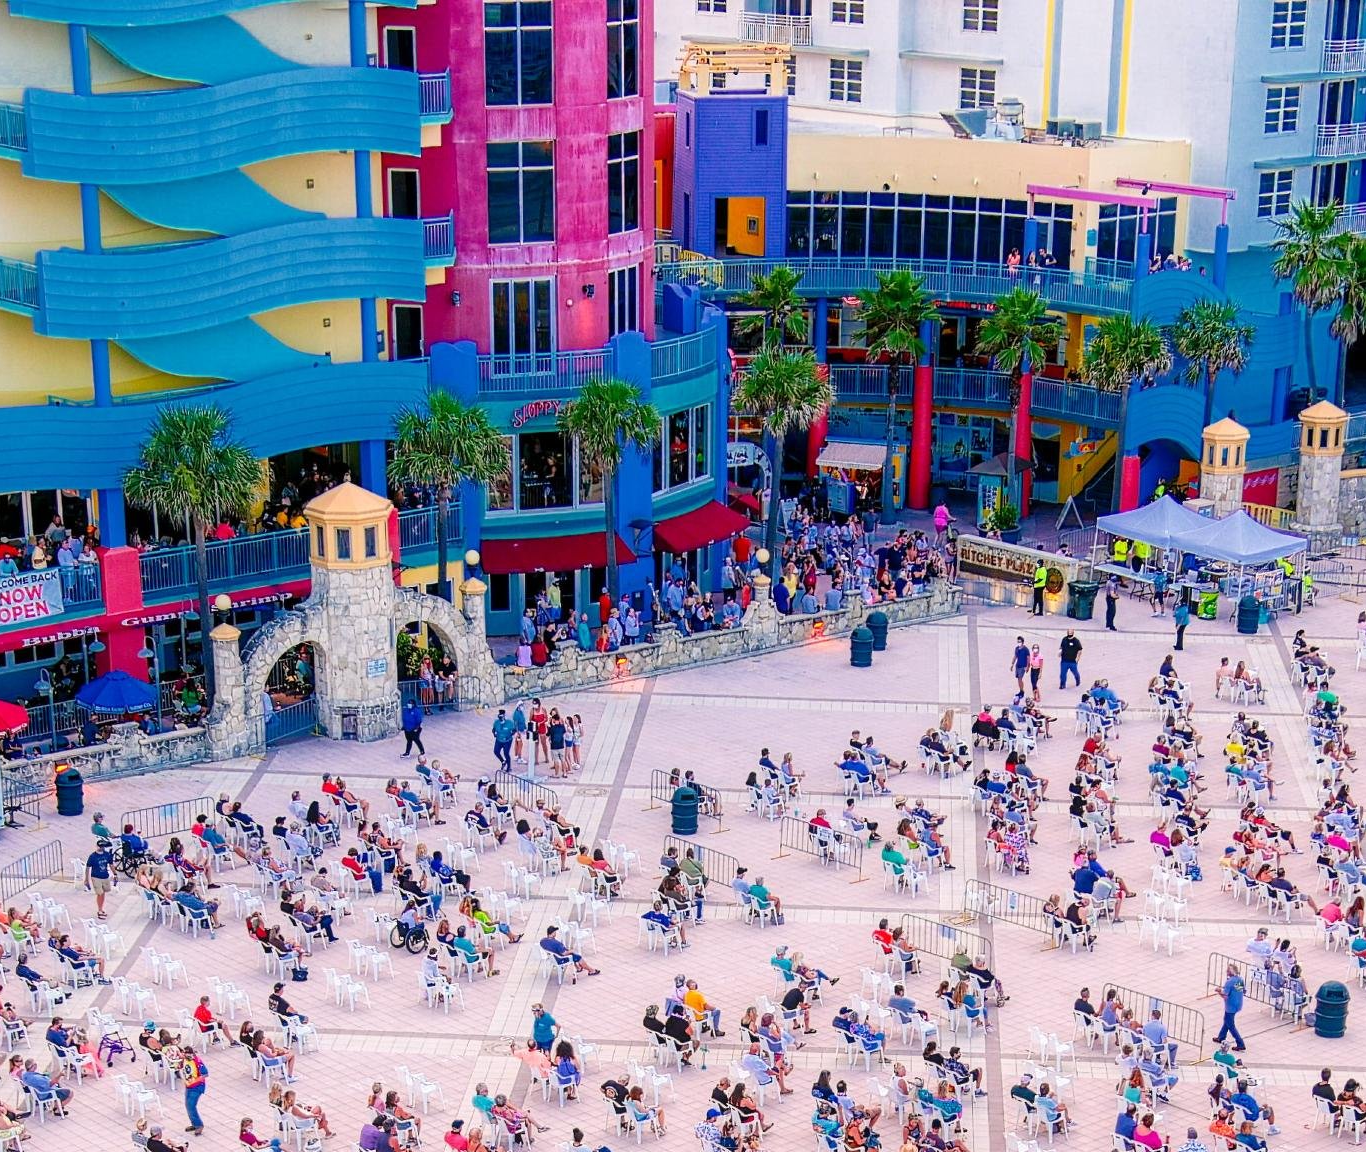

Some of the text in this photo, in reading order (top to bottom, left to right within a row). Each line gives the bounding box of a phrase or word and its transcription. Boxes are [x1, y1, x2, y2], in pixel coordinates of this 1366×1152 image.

[513, 400, 561, 428] SLOPPY
[960, 547, 1034, 575] RITCHEY PLAZ
[31, 571, 57, 583] BACK
[22, 626, 101, 648] Bubba
[210, 591, 294, 613] Srimp
